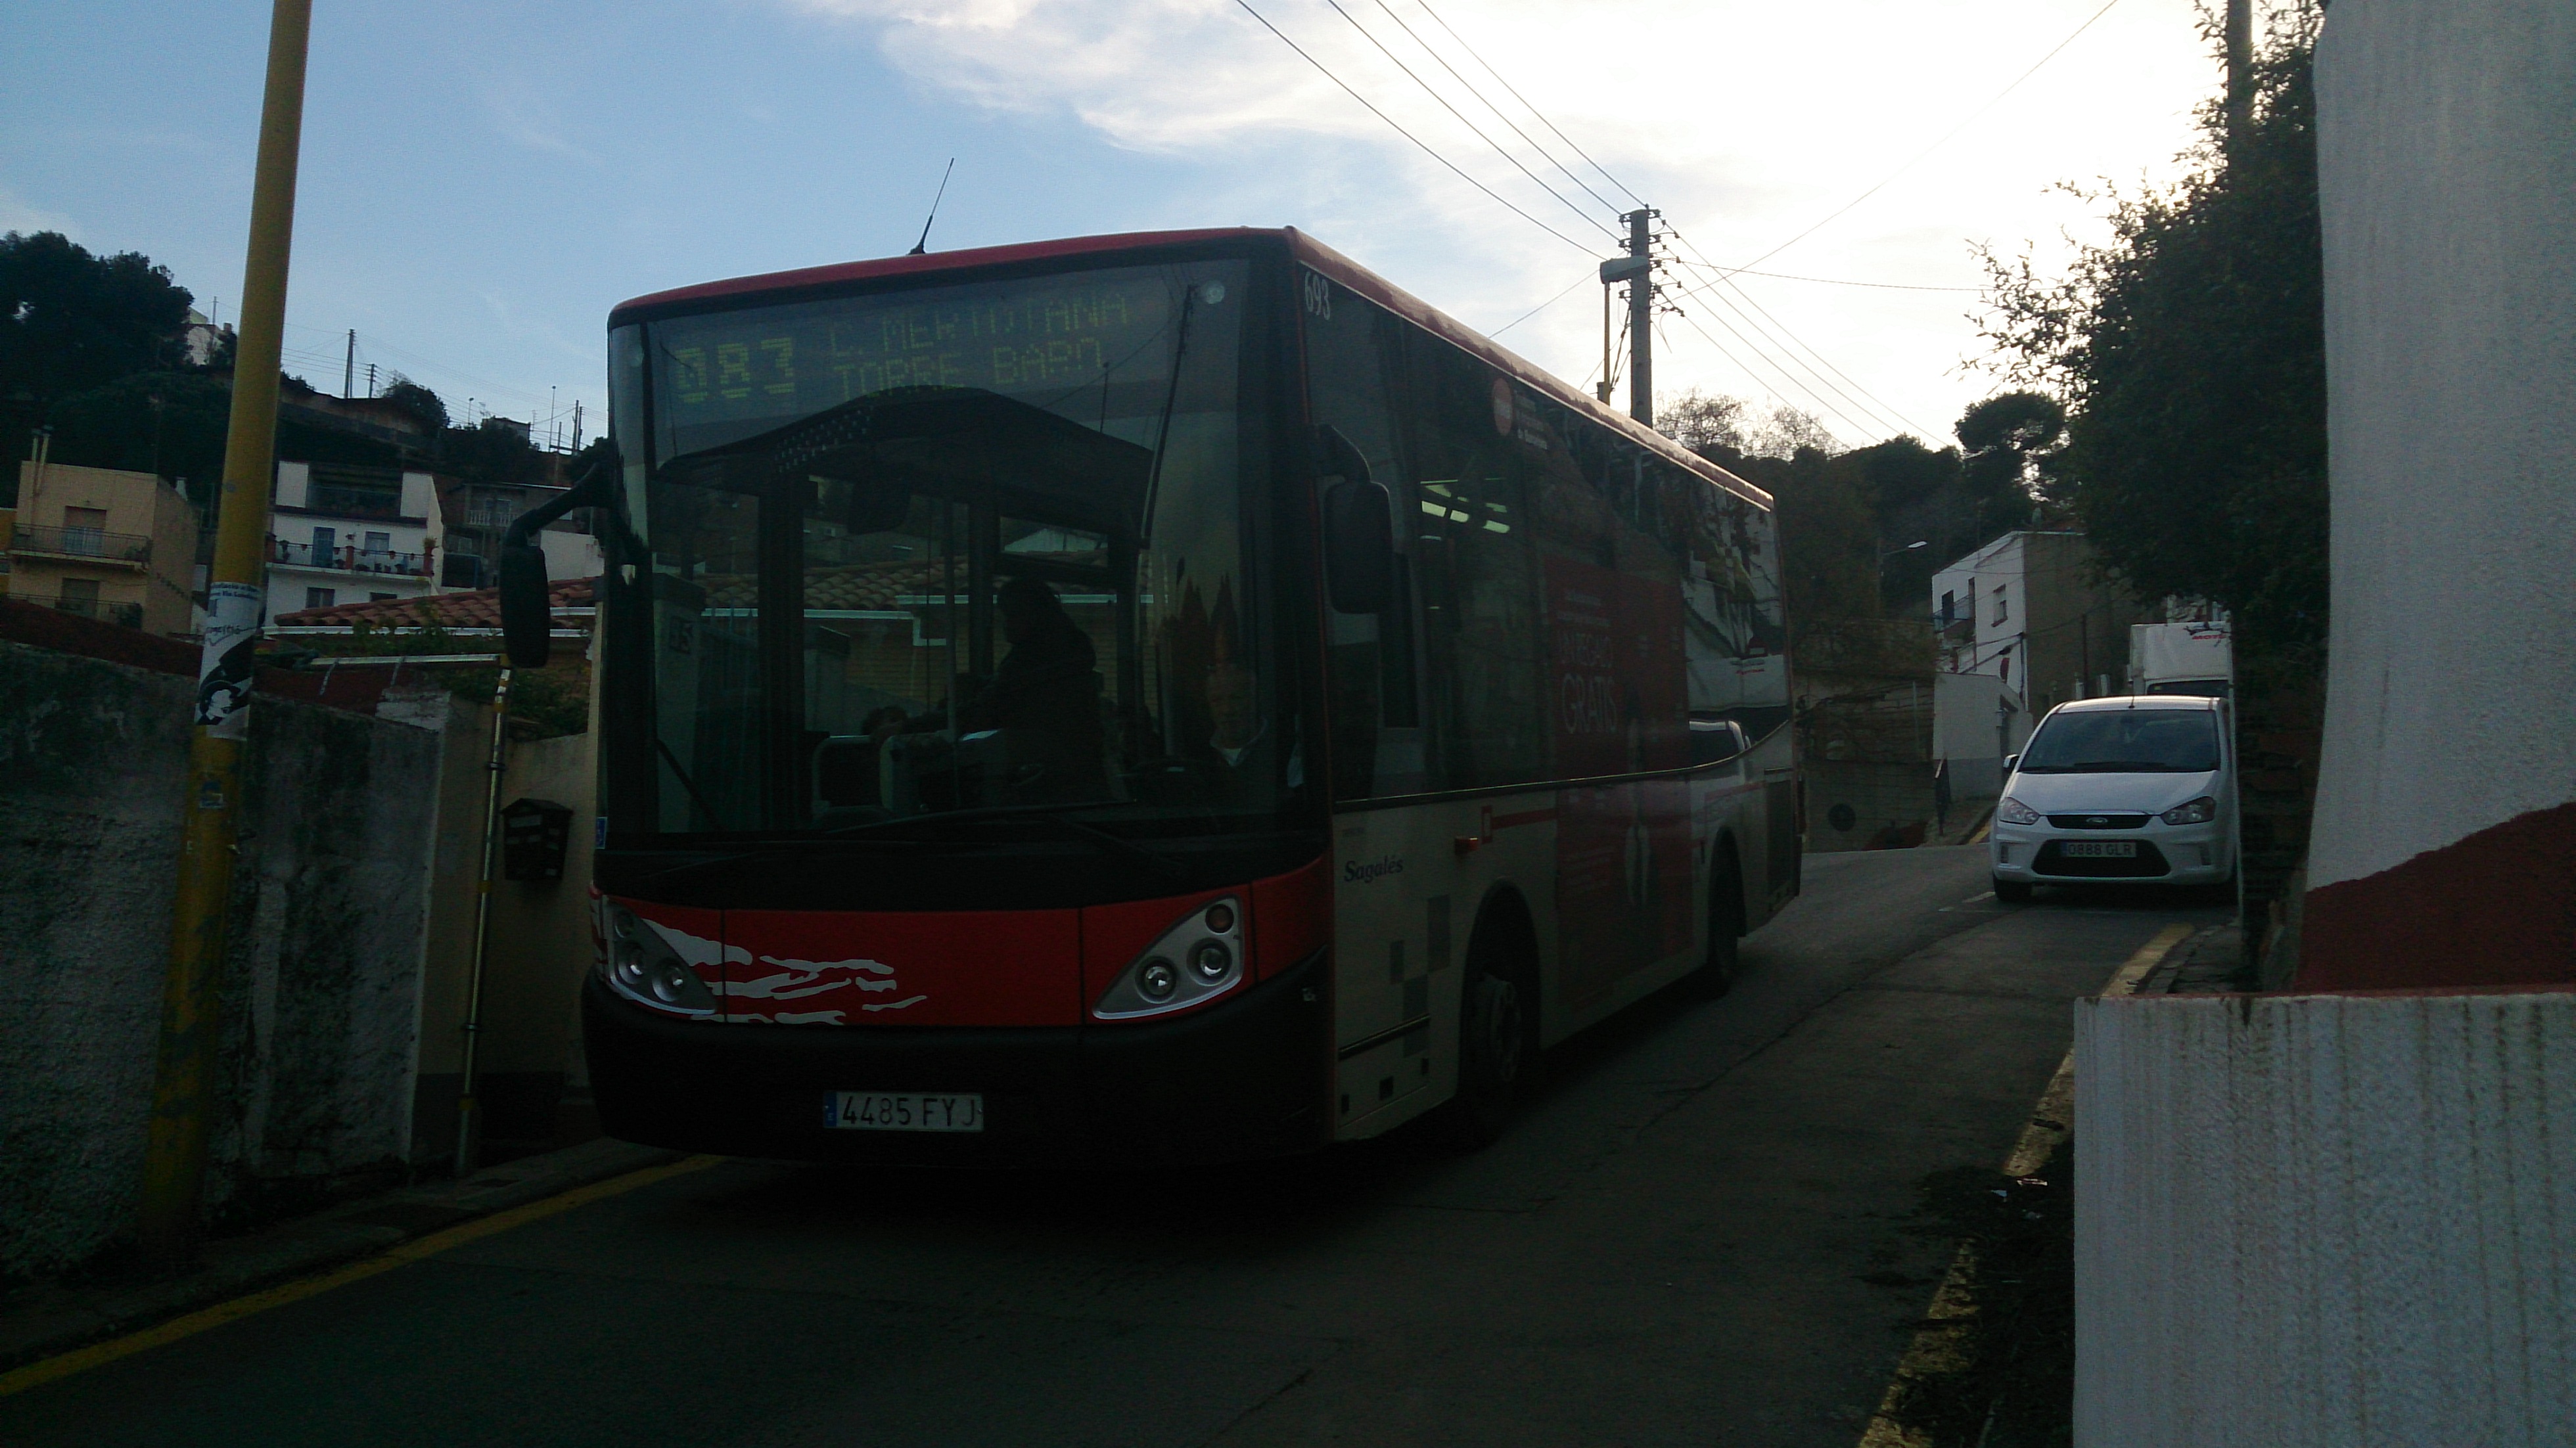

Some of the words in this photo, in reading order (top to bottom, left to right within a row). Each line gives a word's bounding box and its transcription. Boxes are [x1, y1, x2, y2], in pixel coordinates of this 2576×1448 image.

[1305, 271, 1330, 321] 693
[674, 337, 795, 403] 083
[833, 351, 966, 401] TORRE
[2068, 844, 2102, 855] 0888
[843, 1096, 911, 1125] 4485
[923, 1098, 975, 1126] FYJ
